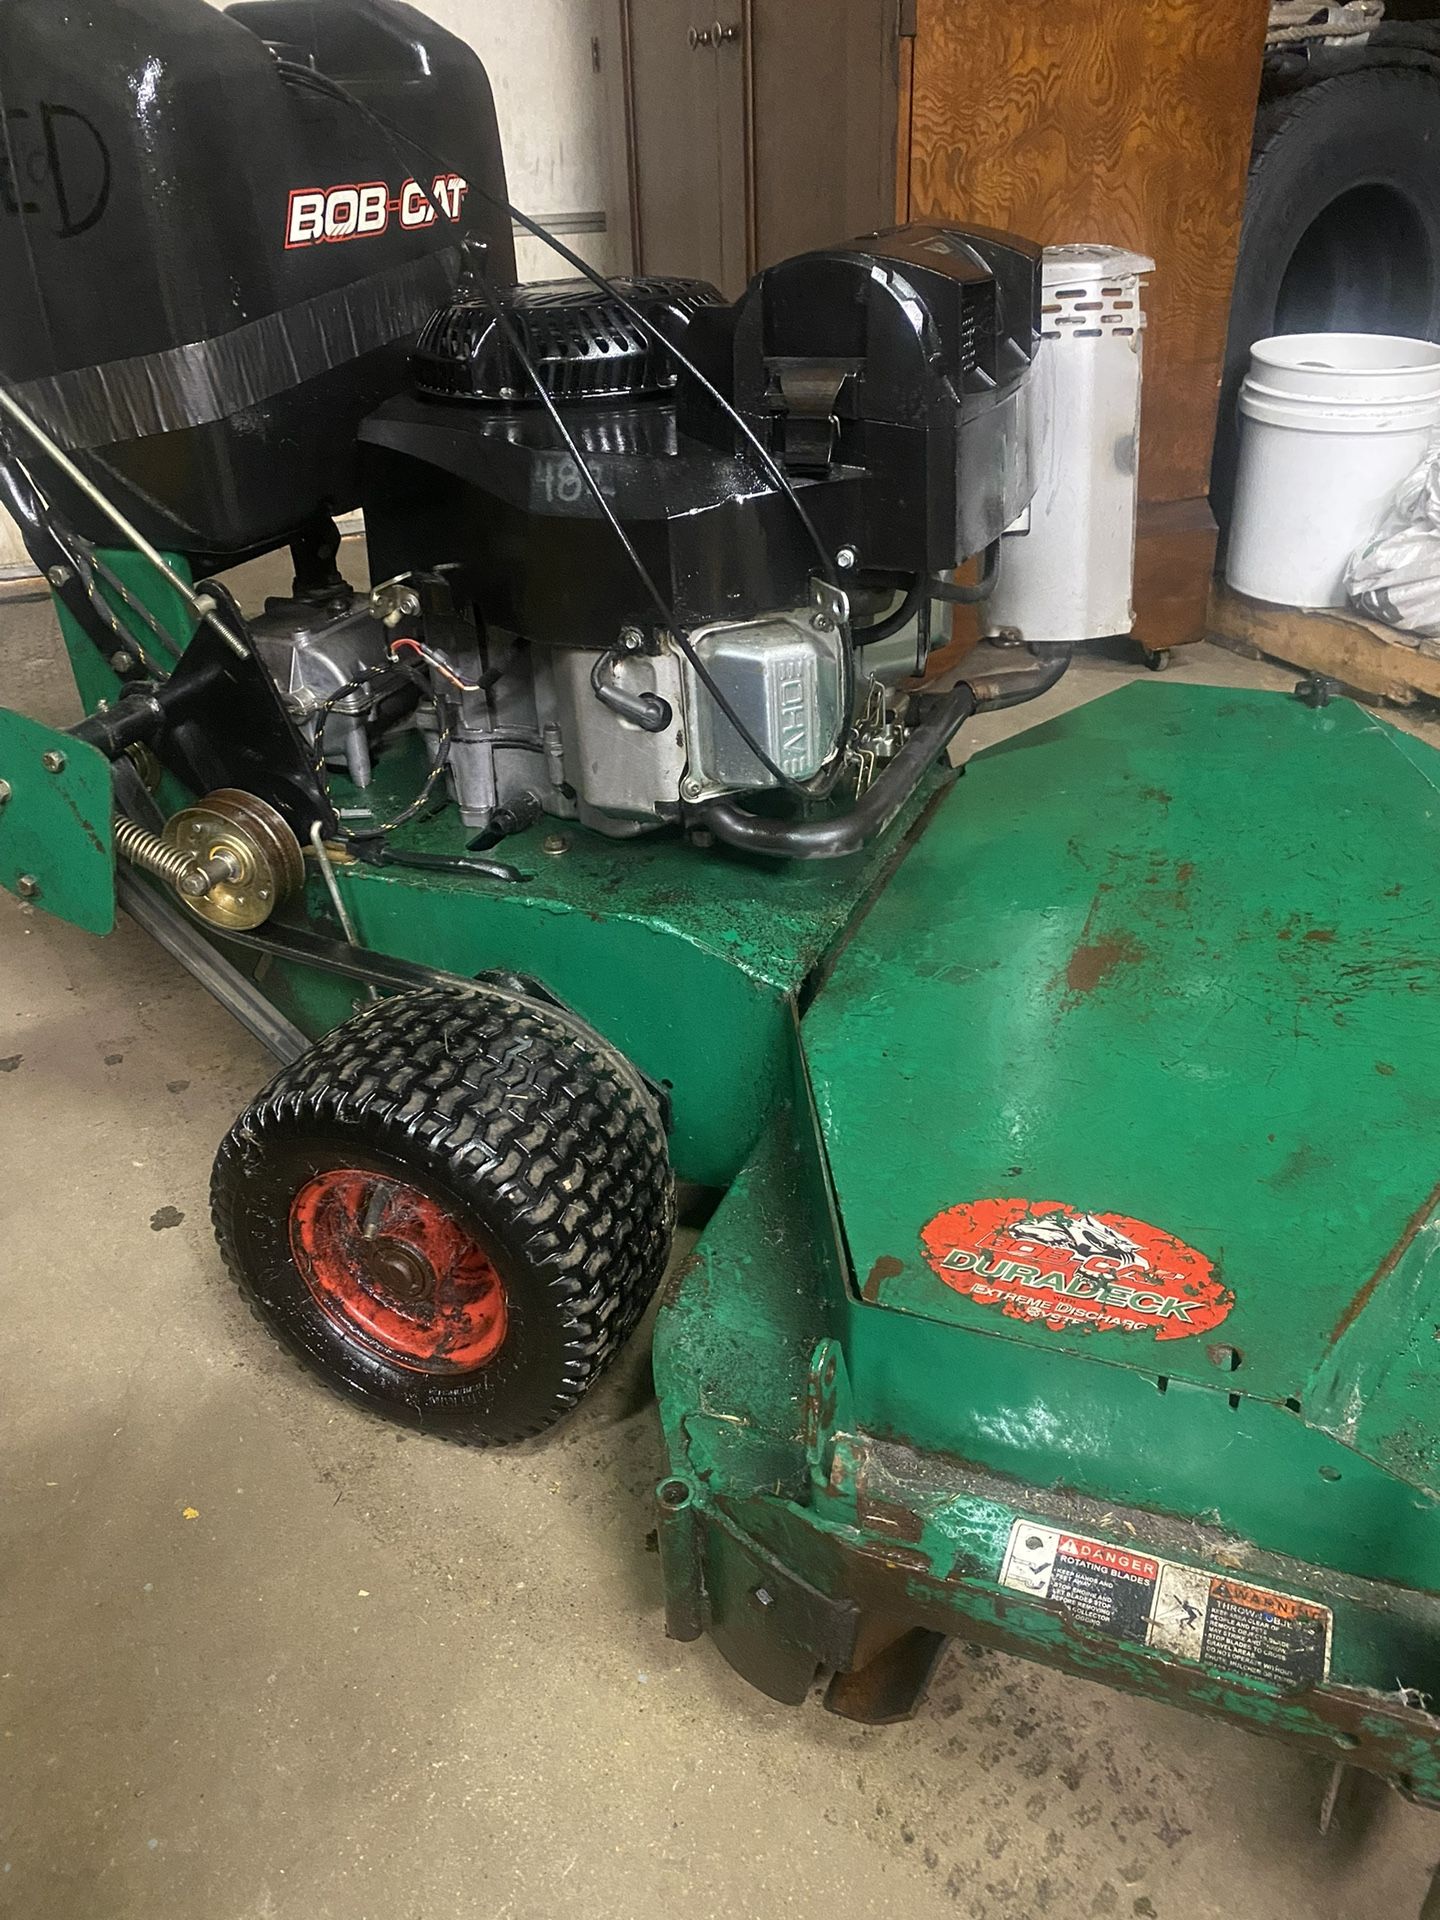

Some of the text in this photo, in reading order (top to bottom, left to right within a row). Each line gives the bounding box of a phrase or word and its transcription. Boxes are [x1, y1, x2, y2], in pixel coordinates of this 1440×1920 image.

[285, 174, 469, 249] BOB-CAT
[940, 1249, 1205, 1324] DURADECK
[970, 1283, 1150, 1331] EXTREME DISCHARG
[1027, 1306, 1088, 1326] SYSTE
[1081, 1545, 1154, 1575] DANGER
[1057, 1568, 1114, 1589] KEEP HANDS AND
[1060, 1554, 1151, 1587] ROTATING BLADES
[1066, 1592, 1093, 1604] BLADES
[1094, 1600, 1112, 1609] STOP
[1097, 1595, 1112, 1603] AND
[1072, 1607, 1110, 1622] COLLECTOR
[1077, 1602, 1111, 1615] REMOVING
[1210, 1613, 1235, 1625] PEOPLE
[1236, 1621, 1250, 1630] AND
[1210, 1620, 1236, 1633] REMOVE
[1247, 1618, 1270, 1629] CLEAR
[1208, 1626, 1221, 1635] MAY
[1206, 1639, 1232, 1652] GRAVEL
[1208, 1633, 1225, 1642] STOP
[1226, 1638, 1252, 1651] BLADES
[1253, 1646, 1262, 1654] TO
